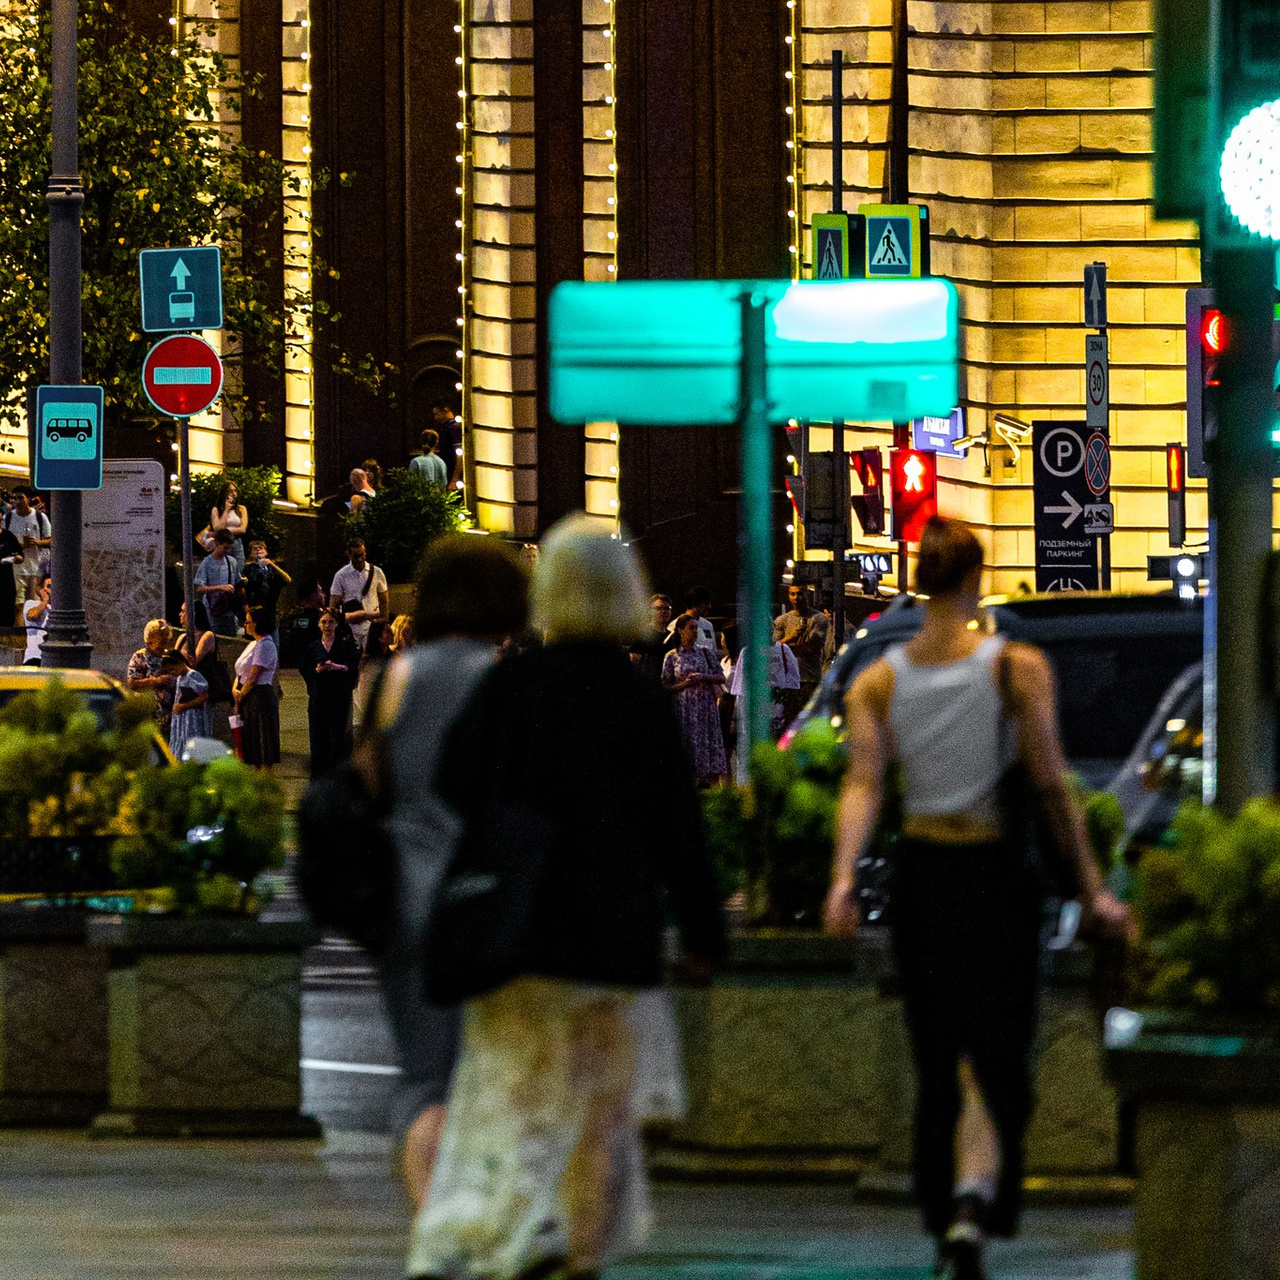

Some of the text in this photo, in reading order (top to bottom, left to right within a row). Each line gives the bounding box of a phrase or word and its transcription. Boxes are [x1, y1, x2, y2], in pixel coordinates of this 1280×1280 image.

[1089, 341, 1103, 352] ЗОНА
[1091, 374, 1102, 391] 30
[1038, 539, 1092, 549] ПОДЗЕМНЫЙ
[1046, 550, 1085, 559] ПАРКИНГ
